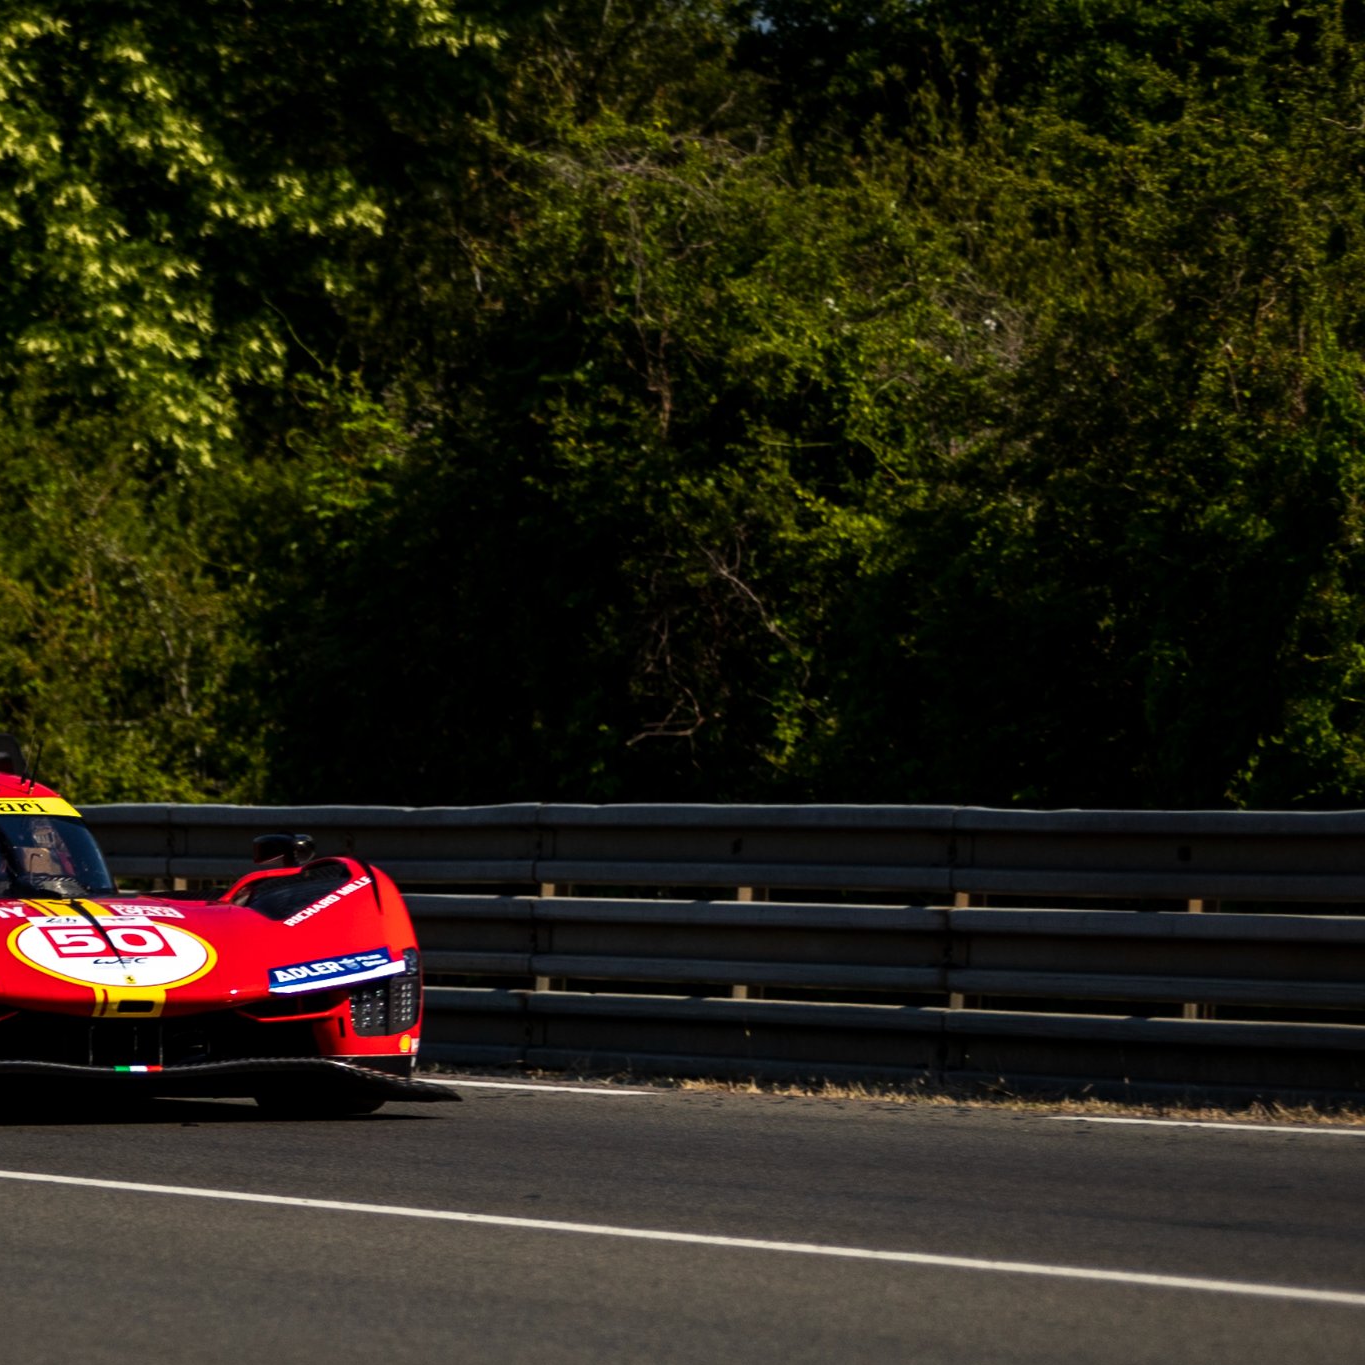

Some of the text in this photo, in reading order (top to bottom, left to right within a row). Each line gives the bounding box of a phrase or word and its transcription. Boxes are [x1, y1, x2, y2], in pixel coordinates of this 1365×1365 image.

[283, 876, 372, 927] RICHARD MILLE
[47, 928, 164, 954] 50
[274, 961, 345, 983] ADLER
